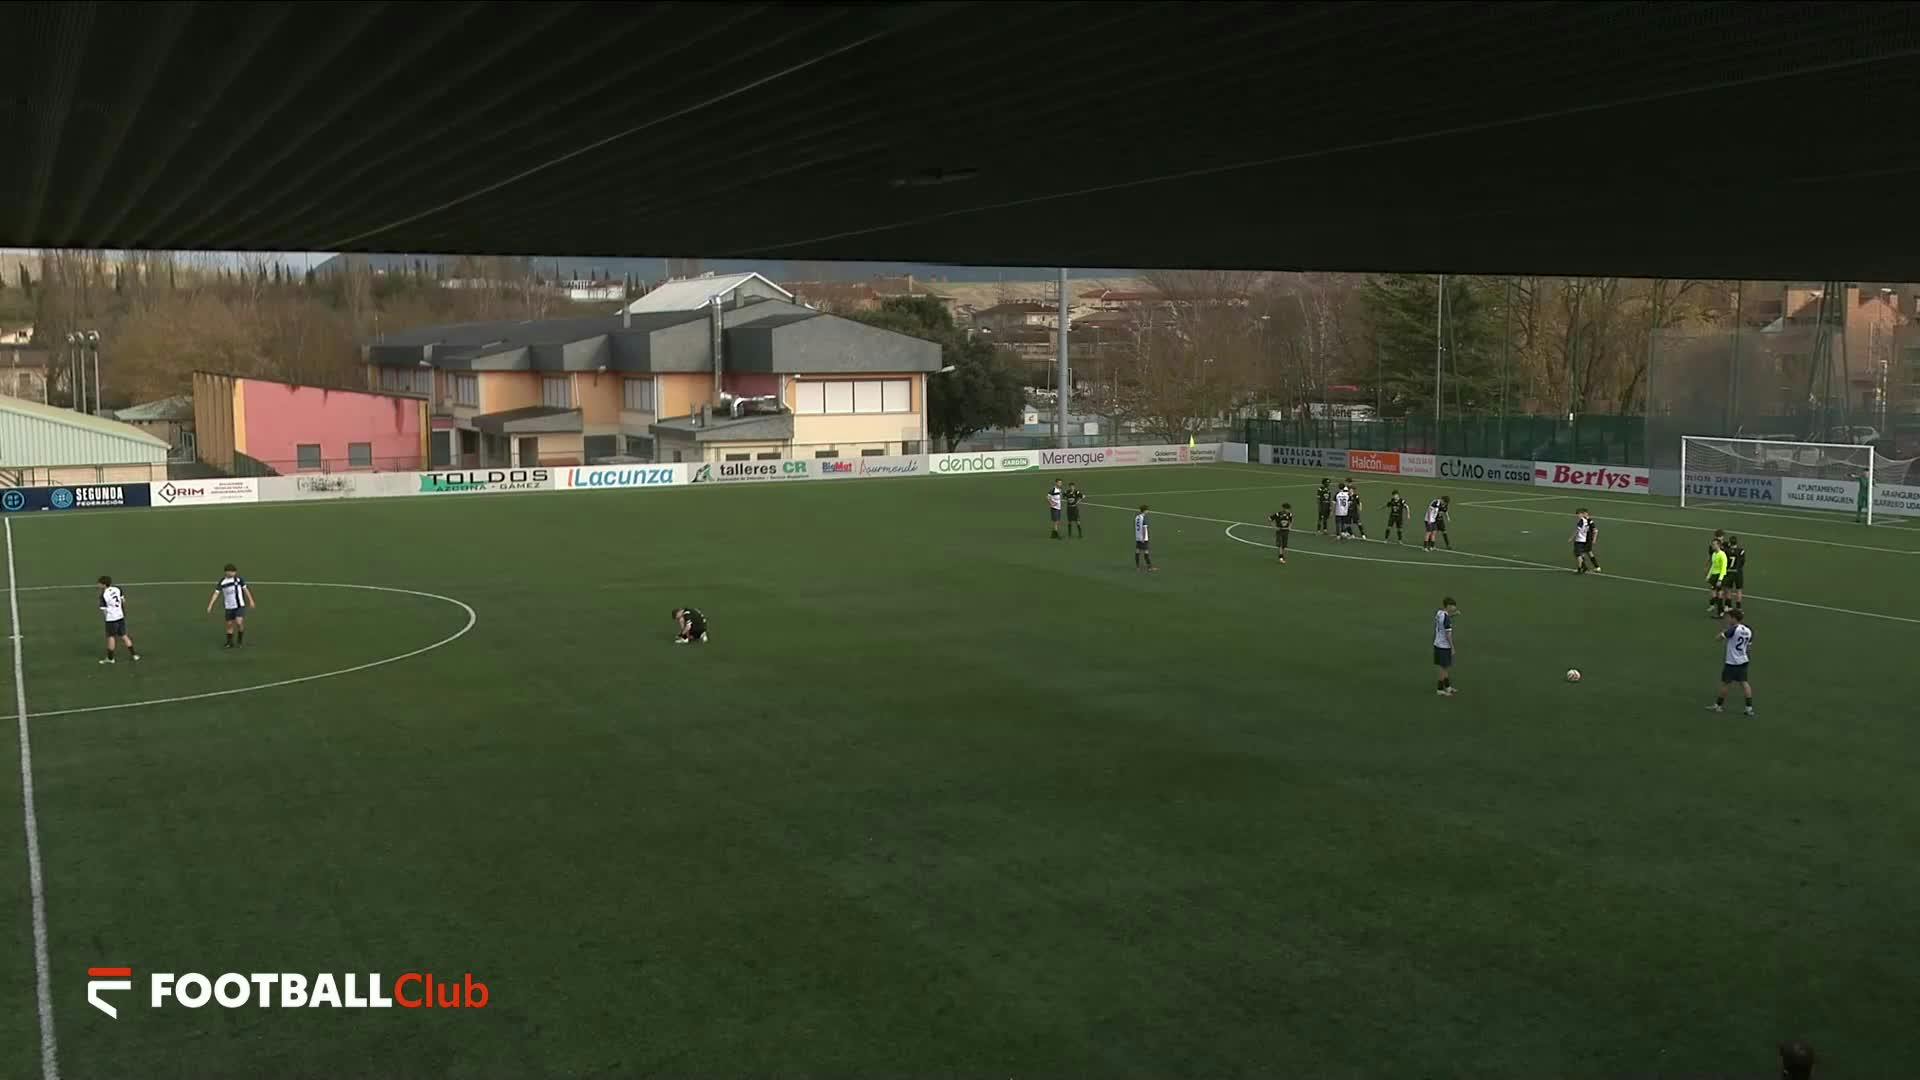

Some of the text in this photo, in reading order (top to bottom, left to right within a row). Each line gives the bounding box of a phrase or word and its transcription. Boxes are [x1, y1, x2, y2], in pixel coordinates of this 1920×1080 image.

[1273, 447, 1323, 458] METALICAS
[939, 453, 995, 472] denda
[1042, 452, 1105, 466] Merengue
[1273, 456, 1323, 467] MUTILVA
[720, 460, 807, 476] talleres CR
[822, 461, 852, 473] BigMat
[427, 469, 549, 486] TOLDOS
[574, 467, 673, 487] Lacunza
[1487, 469, 1501, 479] en
[1504, 470, 1531, 481] casa
[1552, 464, 1631, 489] Berlys
[76, 487, 123, 501] SEGUNDA
[166, 488, 205, 497] URIM
[1796, 484, 1845, 494] AYUNTAMIENTO
[1815, 495, 1854, 504] ARANGUREN
[1730, 557, 1736, 567] 7
[112, 595, 120, 608] 3
